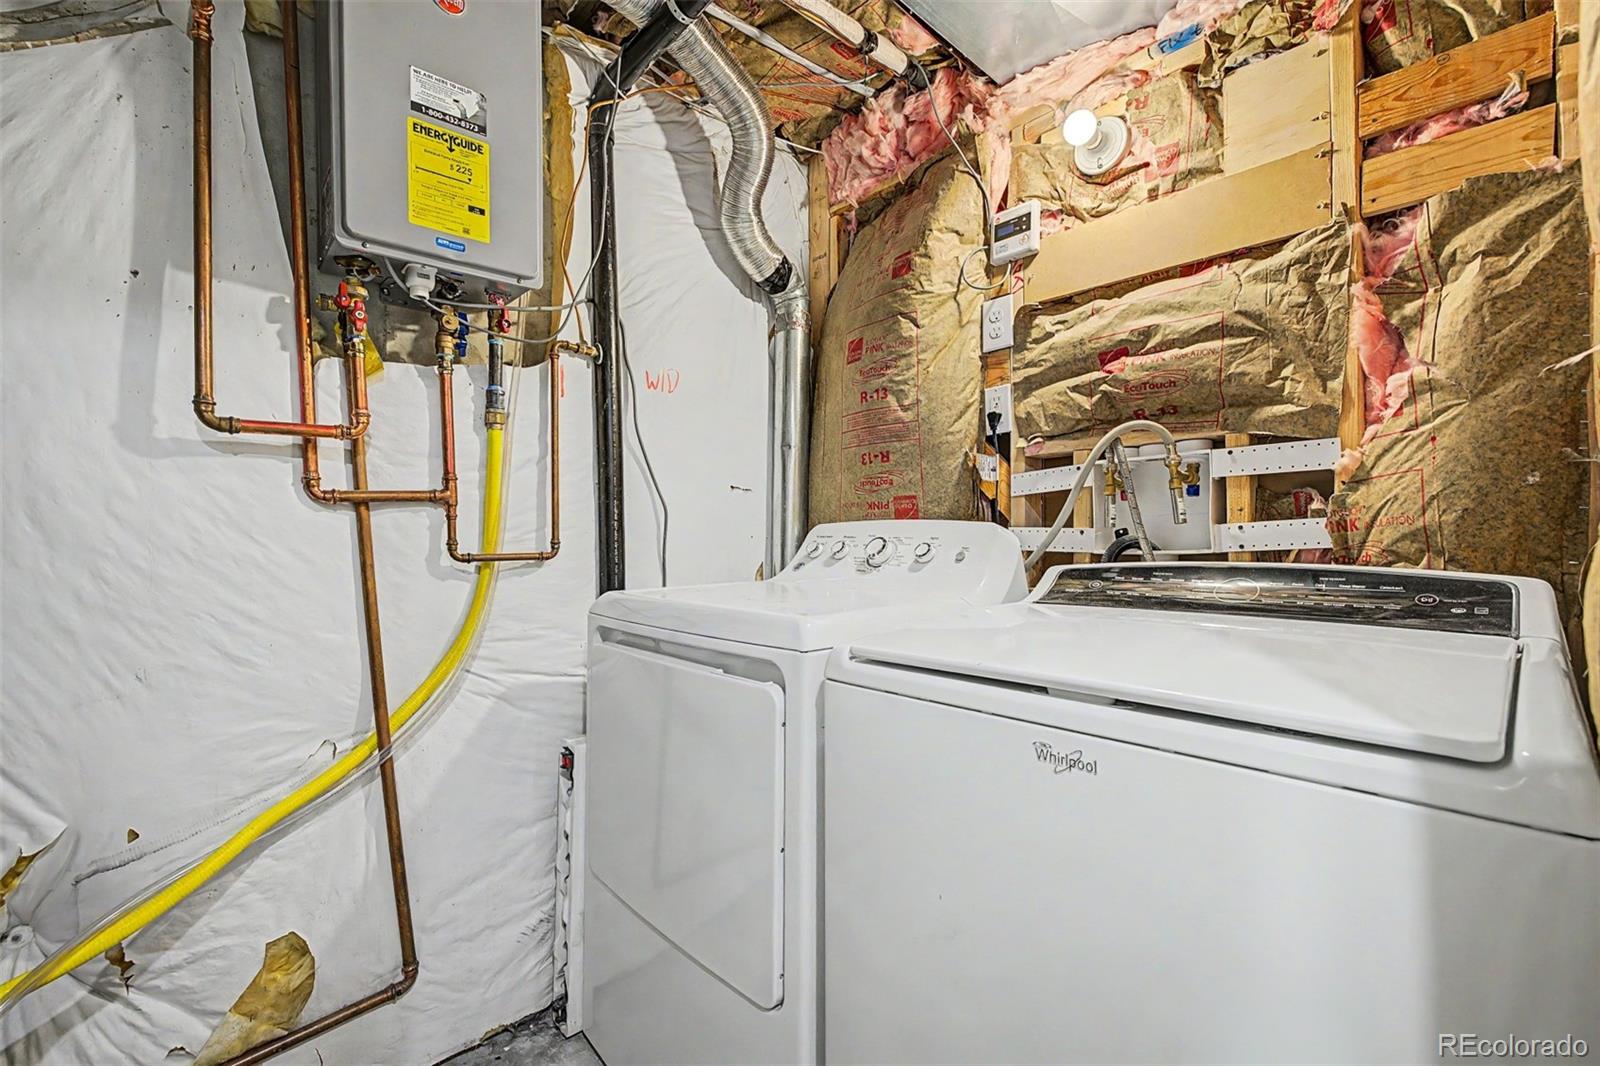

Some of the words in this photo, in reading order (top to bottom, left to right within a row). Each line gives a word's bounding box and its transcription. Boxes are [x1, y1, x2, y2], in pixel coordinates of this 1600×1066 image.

[421, 106, 479, 131] 1-800-432-8373
[1123, 379, 1177, 393] EcoTouch
[860, 387, 889, 404] R-13
[860, 450, 890, 465] R-13
[867, 500, 890, 510] PINK
[1034, 746, 1098, 775] Whirlpool
